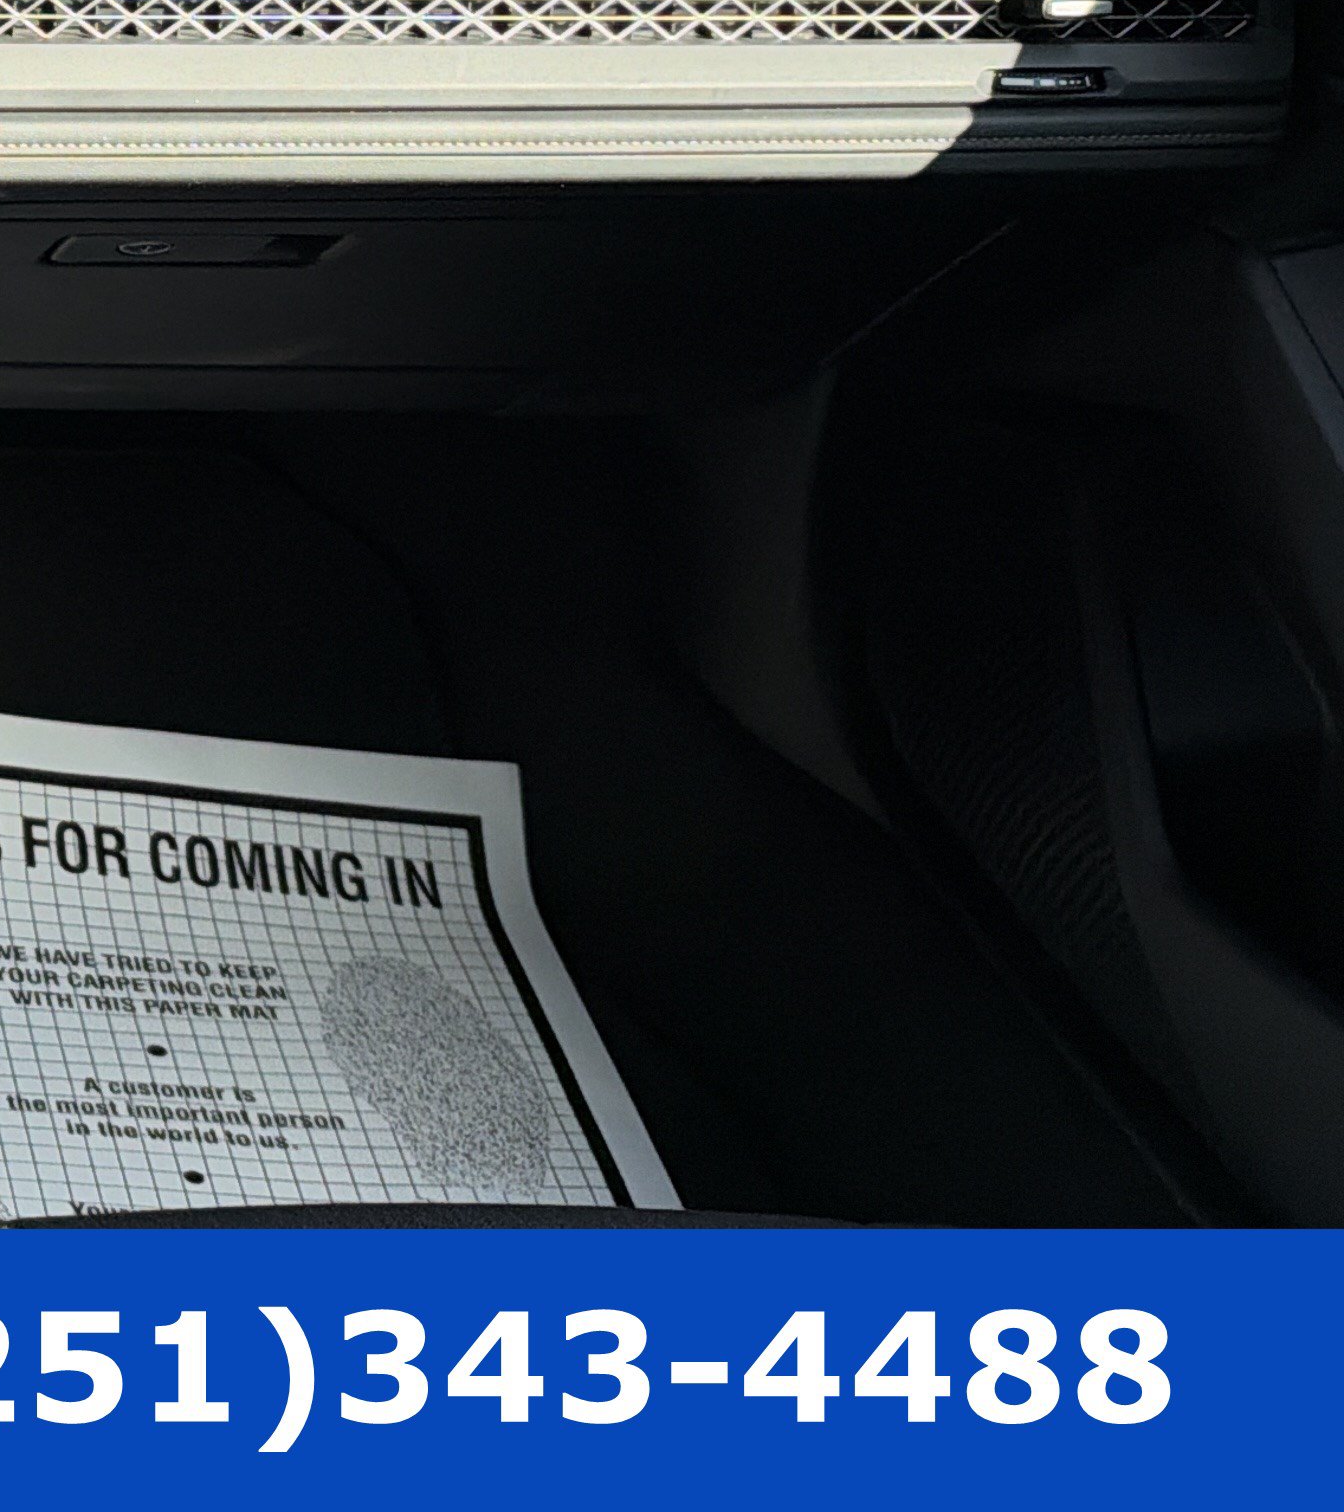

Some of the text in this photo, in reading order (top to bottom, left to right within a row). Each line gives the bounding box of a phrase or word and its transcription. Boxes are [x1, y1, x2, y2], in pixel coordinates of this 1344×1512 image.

[21, 816, 130, 880] FOR
[150, 831, 370, 904] COMING
[387, 855, 442, 910] IN
[35, 948, 102, 968] HAVE
[103, 954, 172, 975] TRIED
[178, 959, 211, 977] TO
[220, 963, 278, 980] KEEP
[66, 971, 203, 997] CARPETING
[211, 982, 288, 1001] CLEAN
[9, 989, 279, 1021] WITH THIS PAPER MAT
[83, 1076, 256, 1103] A customer is
[7, 1093, 346, 1131] the most important person
[66, 1118, 91, 1137] in
[98, 1121, 139, 1140] the
[147, 1126, 219, 1146] world
[225, 1131, 252, 1148] to
